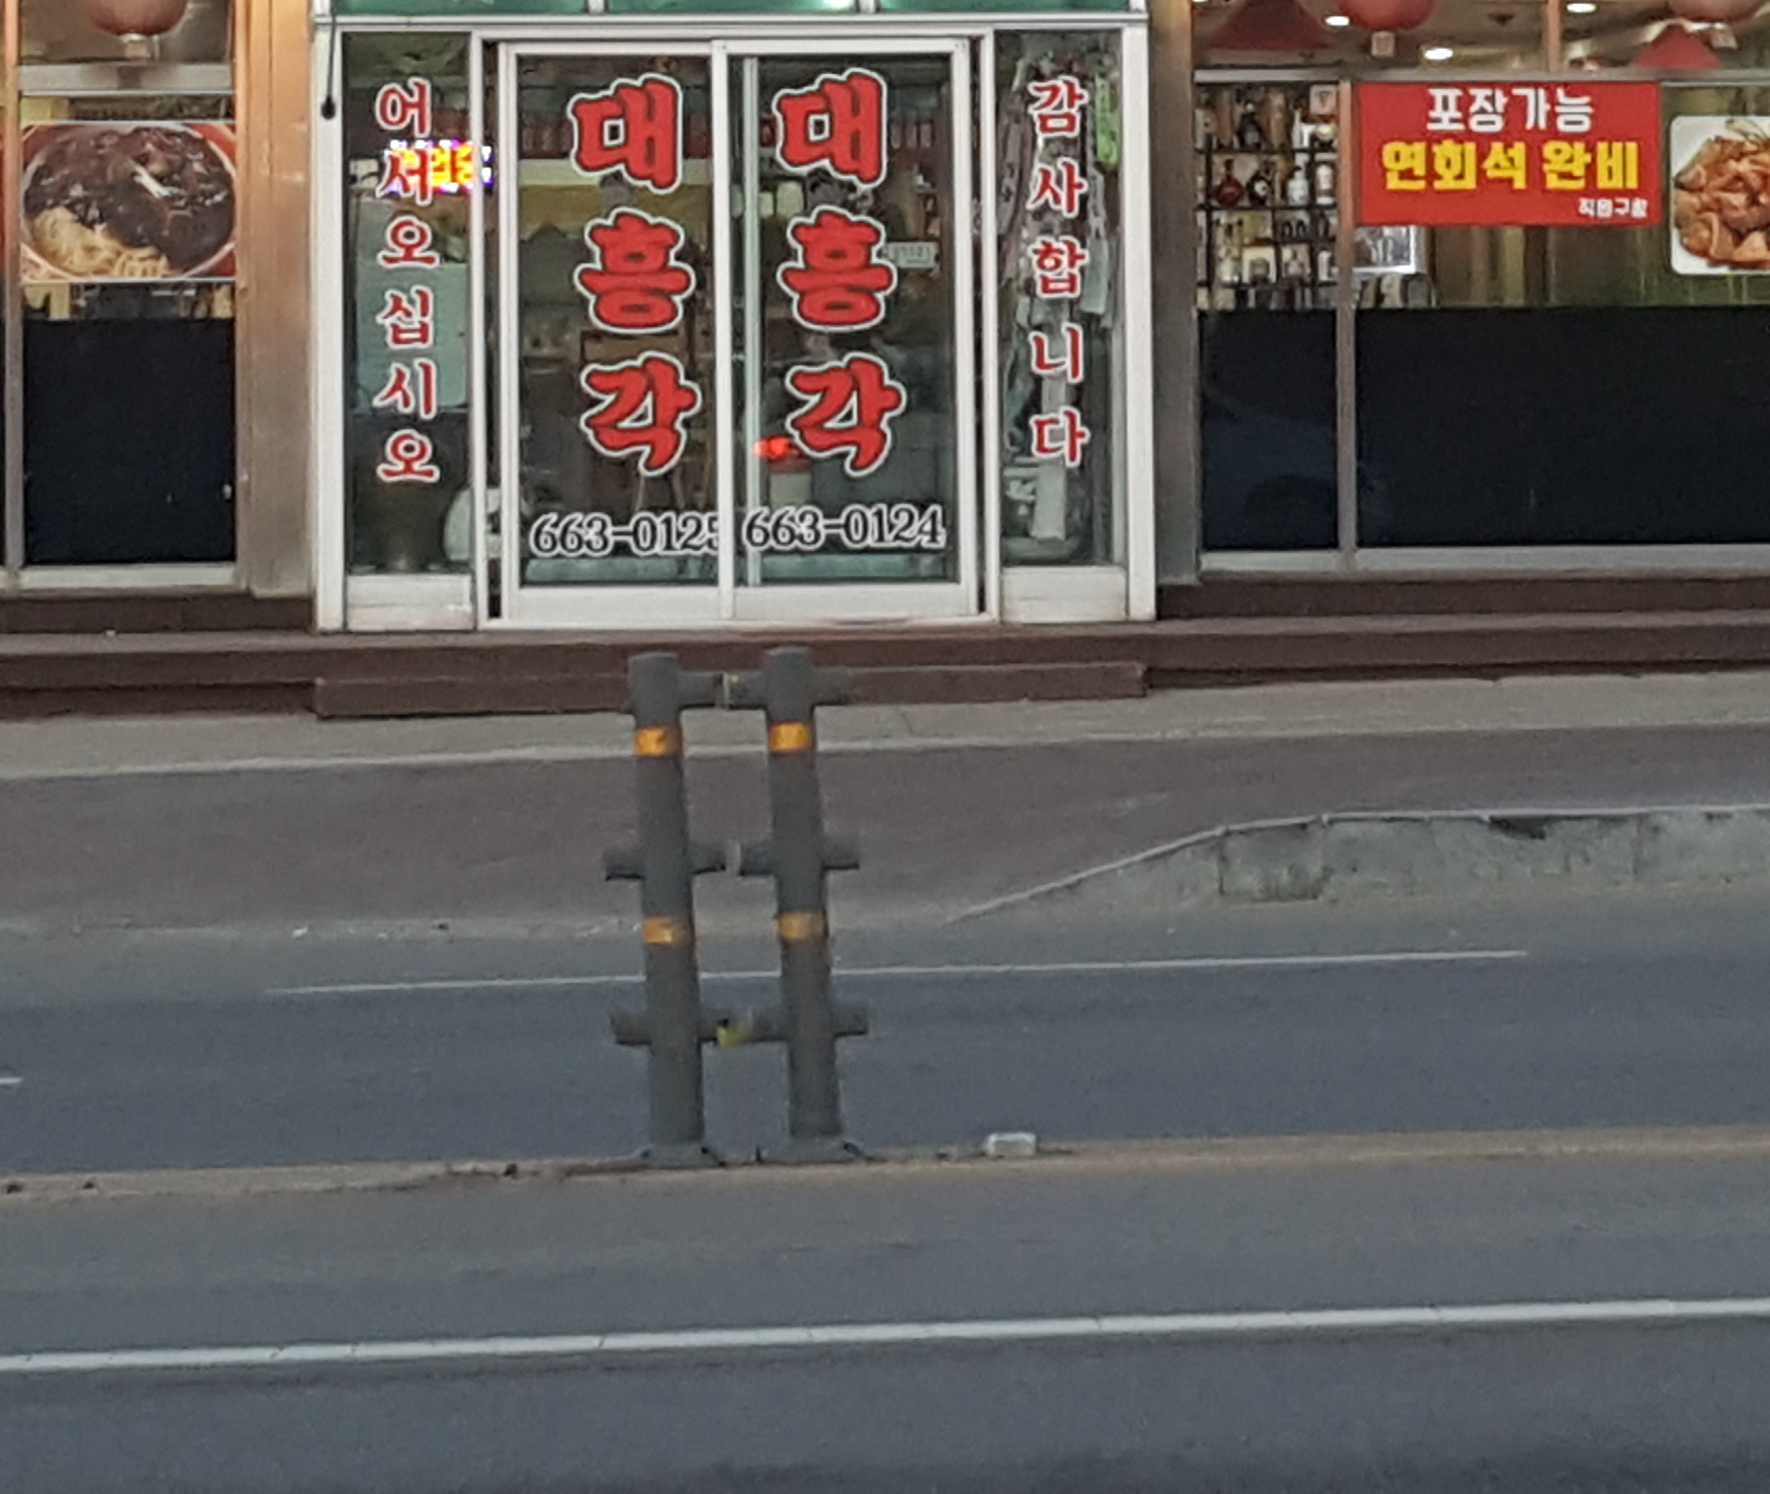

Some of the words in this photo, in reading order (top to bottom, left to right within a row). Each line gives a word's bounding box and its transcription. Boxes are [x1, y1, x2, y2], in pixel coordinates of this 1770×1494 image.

[375, 77, 442, 484] 어서오십시오
[569, 71, 702, 478] 대흥각
[773, 67, 906, 480] 대흥각
[1029, 74, 1090, 470] 감사합니다
[1382, 139, 1528, 191] 연회석
[1542, 139, 1640, 190] 완비
[742, 504, 948, 551] 663-0124
